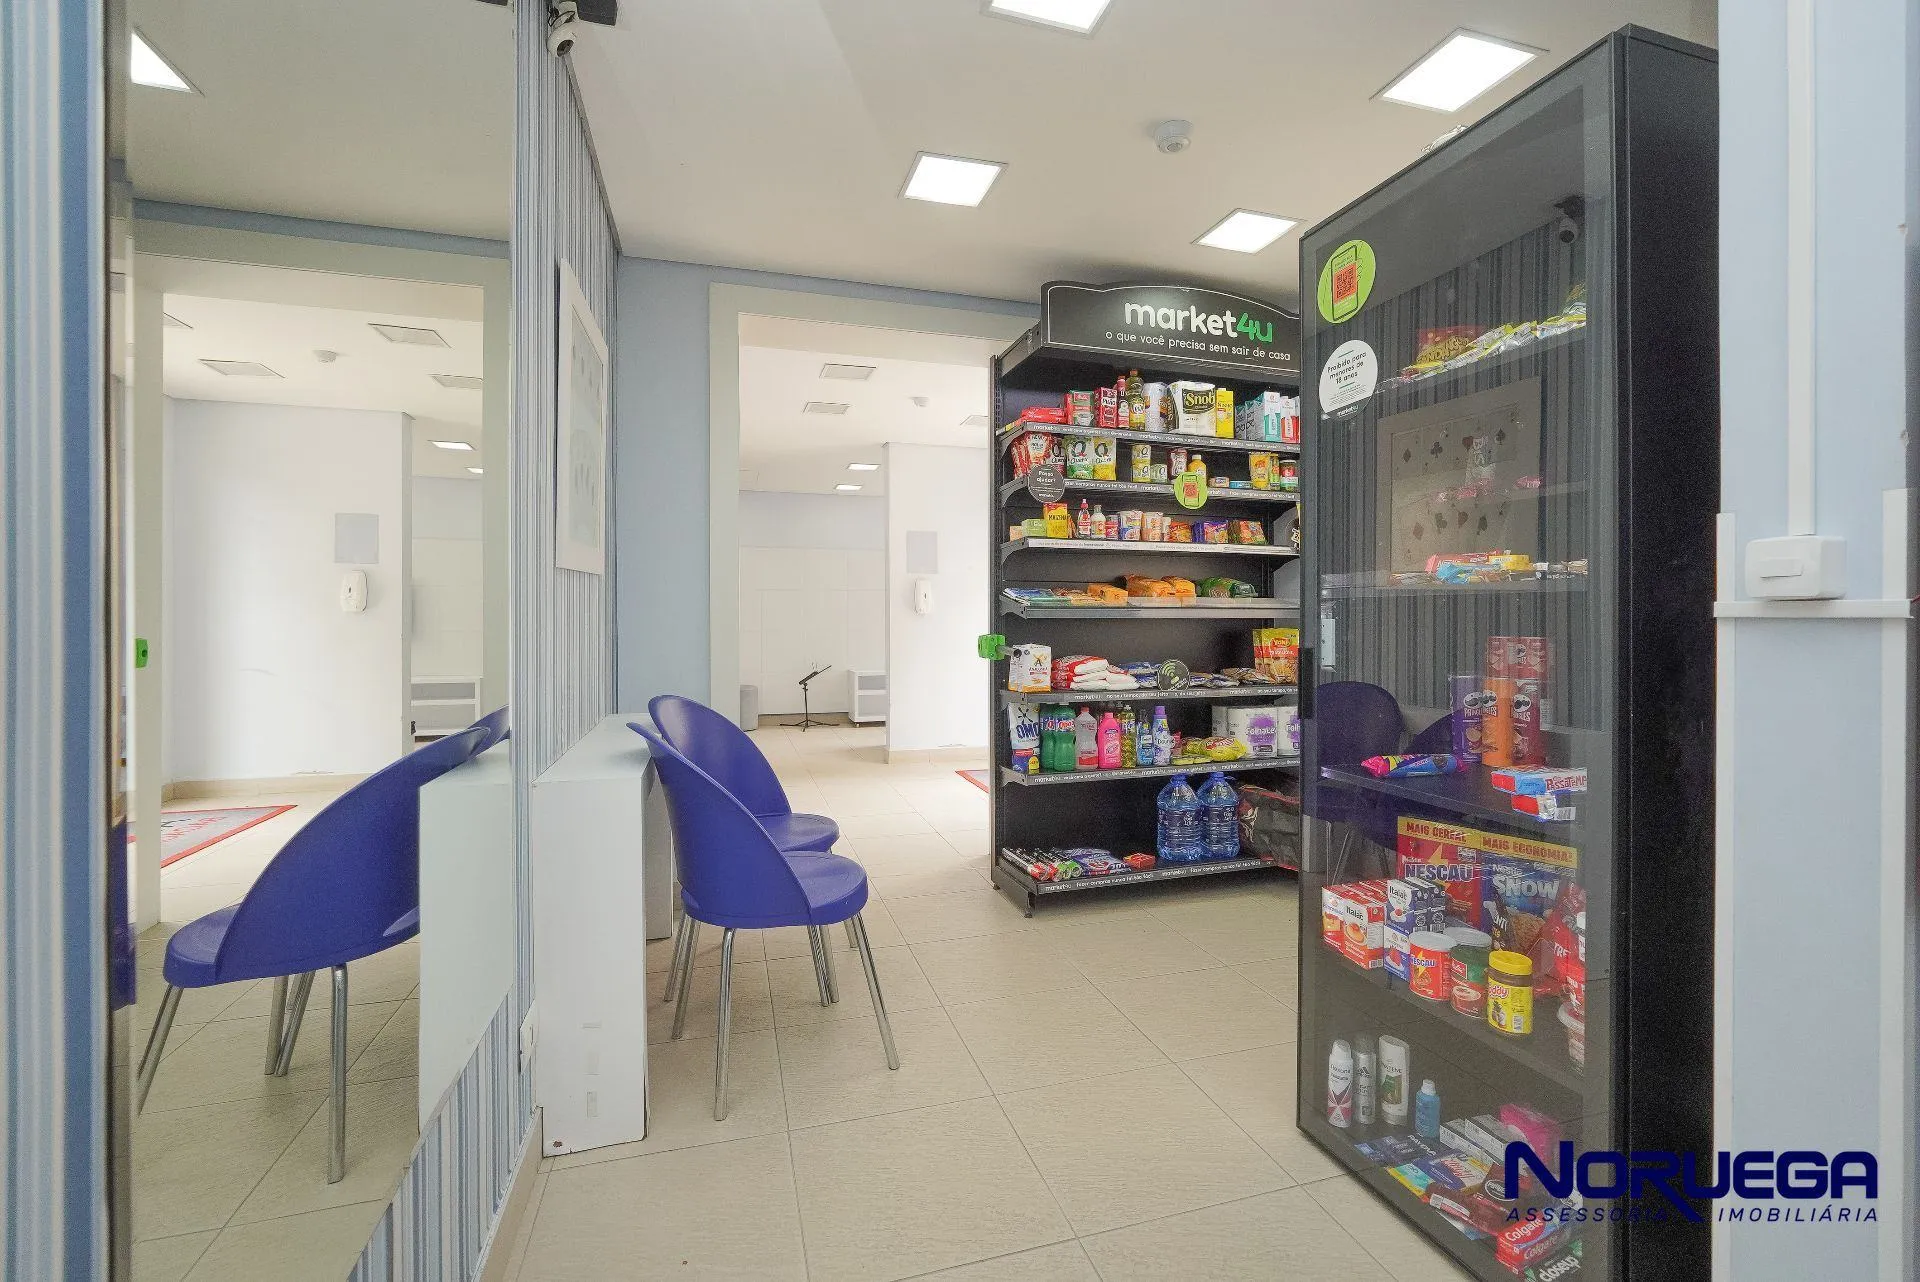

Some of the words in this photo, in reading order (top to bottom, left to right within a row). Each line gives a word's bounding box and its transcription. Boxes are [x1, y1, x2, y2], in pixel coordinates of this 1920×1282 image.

[1124, 302, 1273, 343] market4u
[1105, 331, 1113, 340] o
[1116, 333, 1137, 344] que
[1139, 334, 1165, 346] você
[1168, 338, 1206, 352] precisa
[1209, 344, 1229, 354] sem
[1231, 345, 1251, 356] sair
[1252, 346, 1266, 358] de
[1268, 351, 1291, 361] casa
[1327, 359, 1351, 373] Proibido
[1184, 391, 1215, 407] Snob
[1406, 822, 1430, 836] MAIS
[1432, 827, 1467, 842] CEREAL
[1482, 836, 1510, 851] MAIS
[1405, 863, 1474, 882] NESCAU
[1492, 873, 1560, 900] SNOW
[1346, 905, 1364, 921] Italac
